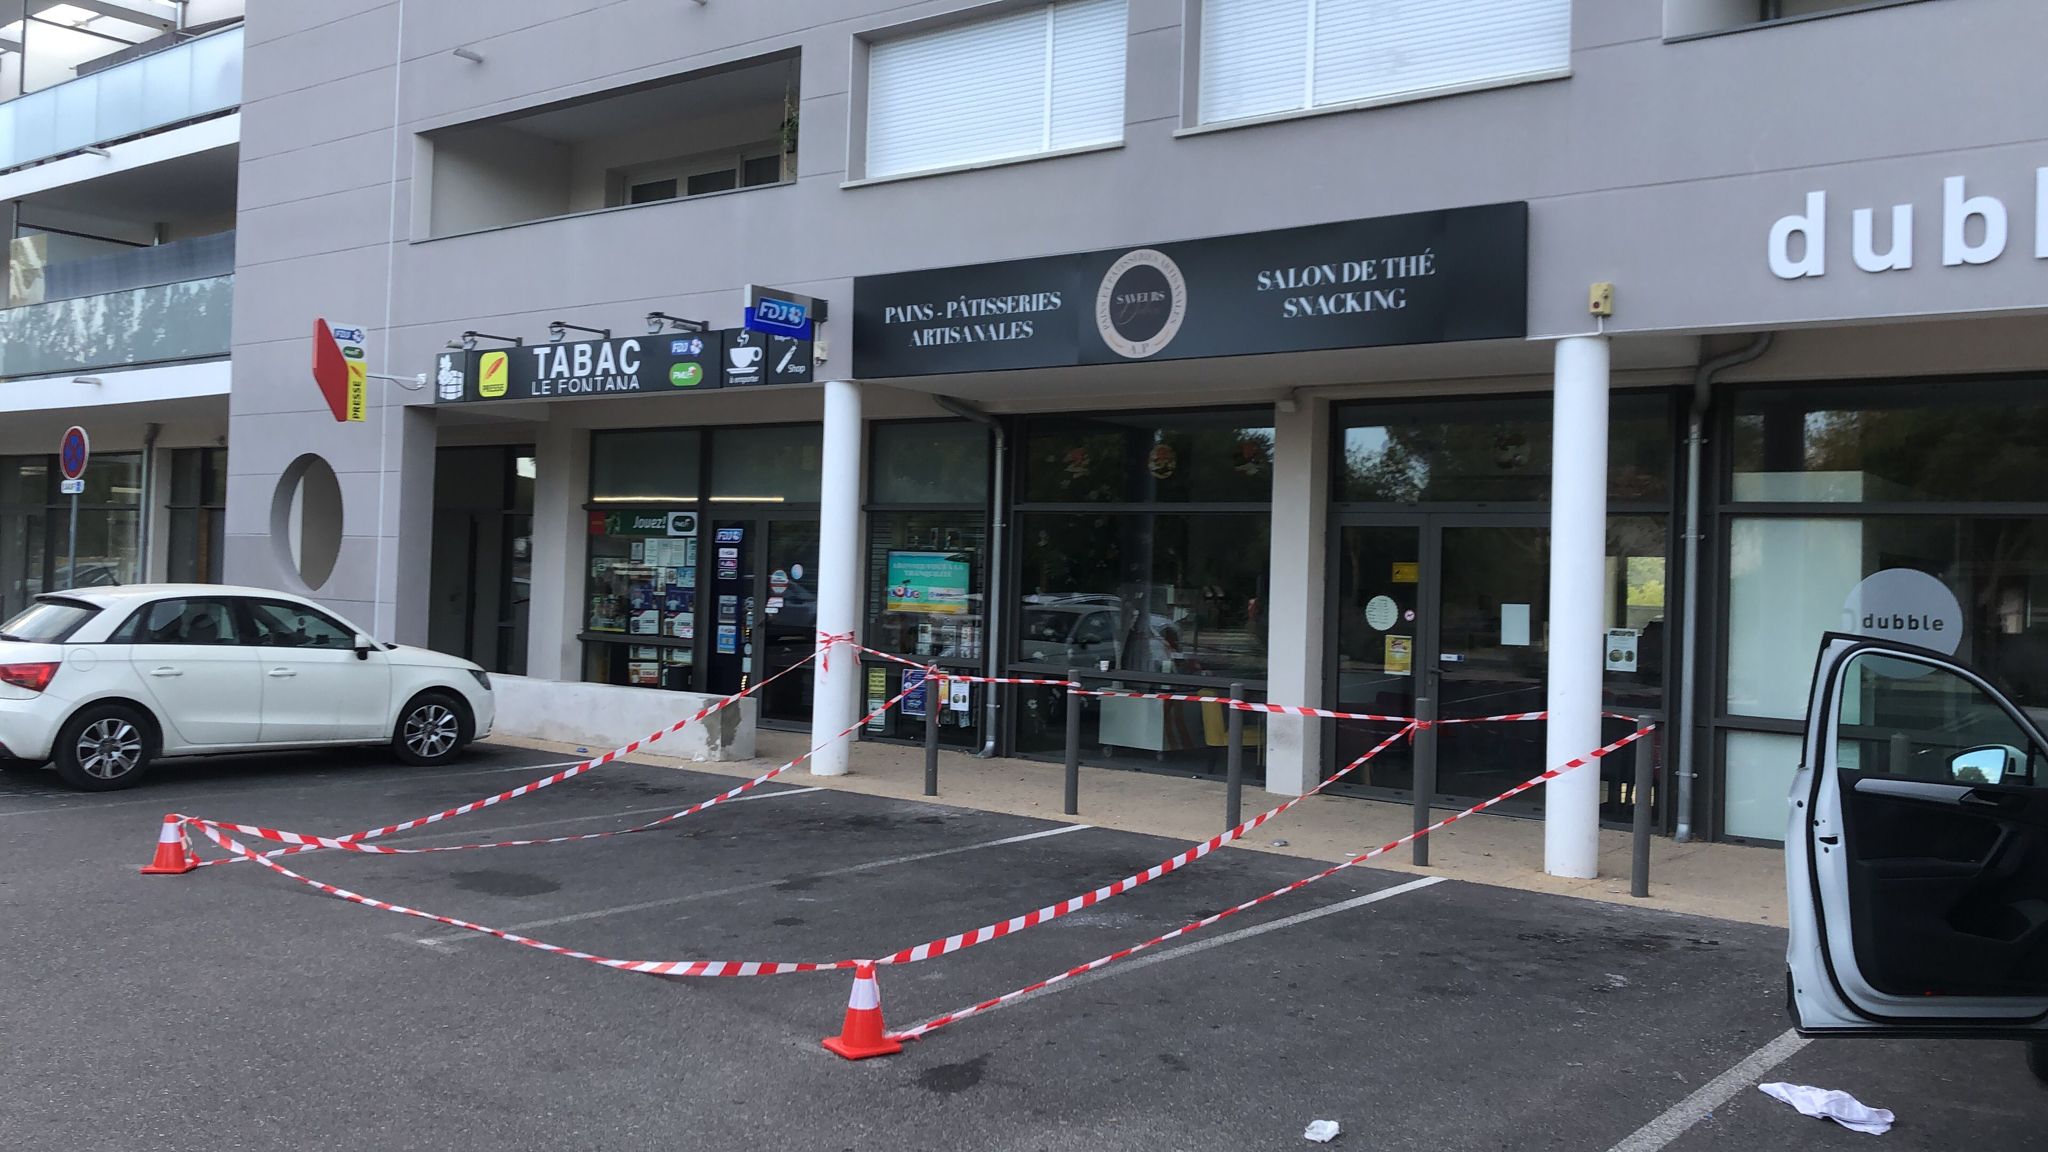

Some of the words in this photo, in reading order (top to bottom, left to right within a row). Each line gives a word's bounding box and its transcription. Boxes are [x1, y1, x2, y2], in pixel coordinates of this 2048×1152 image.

[1257, 264, 1337, 291] SALON
[1342, 259, 1377, 283] DE
[1381, 248, 1435, 279] THÉ
[885, 303, 935, 324] PAINS
[946, 292, 1062, 319] PÂTISSERIES
[1116, 291, 1165, 304] SAVEURS
[1283, 288, 1407, 318] SNACKING
[759, 301, 789, 321] FDJ
[910, 320, 1034, 347] ARTISANALES
[672, 342, 689, 353] FDJ
[533, 339, 641, 379] TABAC
[787, 364, 806, 374] Shop
[531, 381, 551, 396] LE
[558, 375, 641, 393] FONTANA
[352, 381, 361, 419] PRESSE
[633, 515, 667, 529] Jouez!
[1862, 613, 1944, 631] dubble
